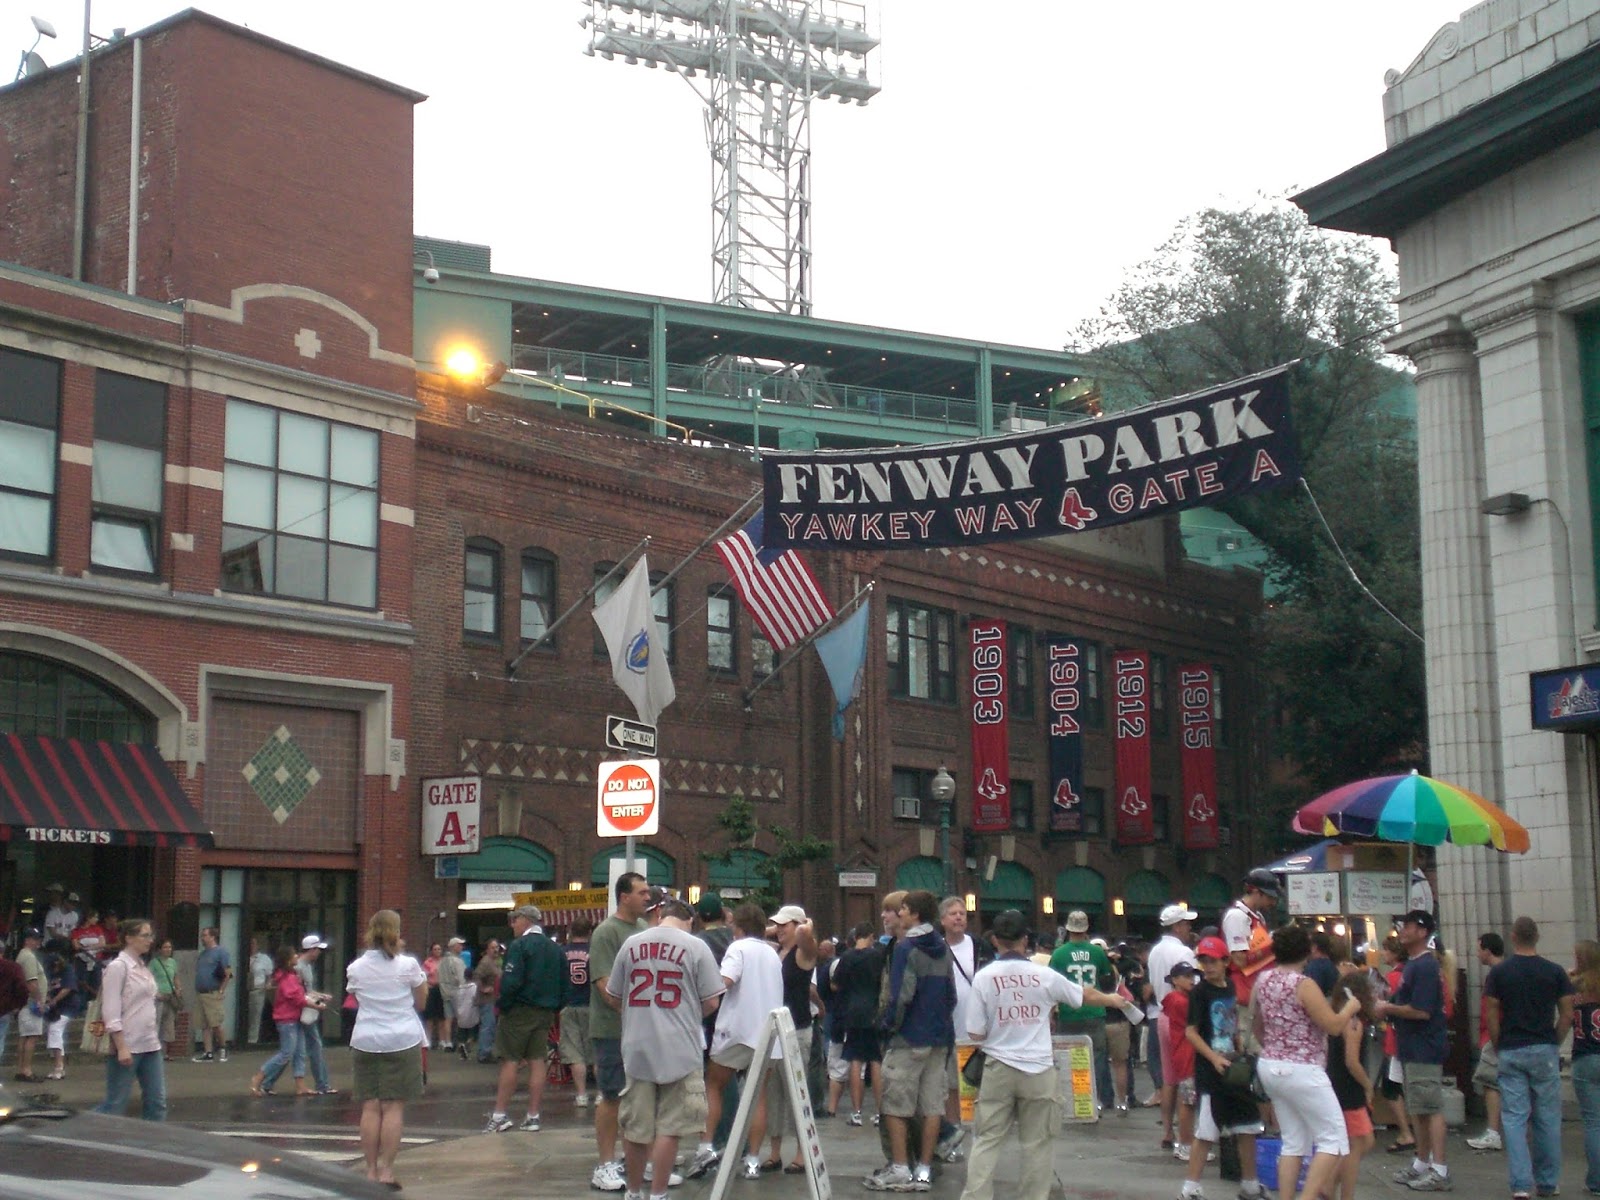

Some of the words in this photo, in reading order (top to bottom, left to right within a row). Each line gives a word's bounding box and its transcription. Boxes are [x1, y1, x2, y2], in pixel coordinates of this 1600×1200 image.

[777, 443, 1040, 504] FENWAY
[1058, 389, 1275, 483] PARK
[779, 510, 936, 541] YAWKEY
[955, 498, 1042, 536] WAY
[1108, 461, 1224, 513] GATE
[1251, 448, 1283, 483] A
[973, 627, 1004, 725] 1903
[1050, 644, 1080, 737] 1904
[1116, 658, 1146, 739] 1912
[1181, 670, 1212, 750] 1915
[622, 728, 636, 742] ONE
[639, 733, 653, 745] WAY
[428, 783, 477, 806] GATE
[608, 780, 624, 792] DO
[627, 778, 649, 791] NOT
[611, 806, 645, 818] ENTER
[26, 827, 111, 844] TICKETS
[435, 811, 466, 847] A
[629, 942, 687, 967] LOWELL
[1071, 950, 1091, 962] BIRD
[569, 961, 587, 985] 5
[992, 973, 1041, 997] JESUS
[1067, 964, 1097, 989] 33
[628, 968, 684, 1010] 25
[1012, 990, 1024, 1002] IS
[998, 1004, 1041, 1022] LORD
